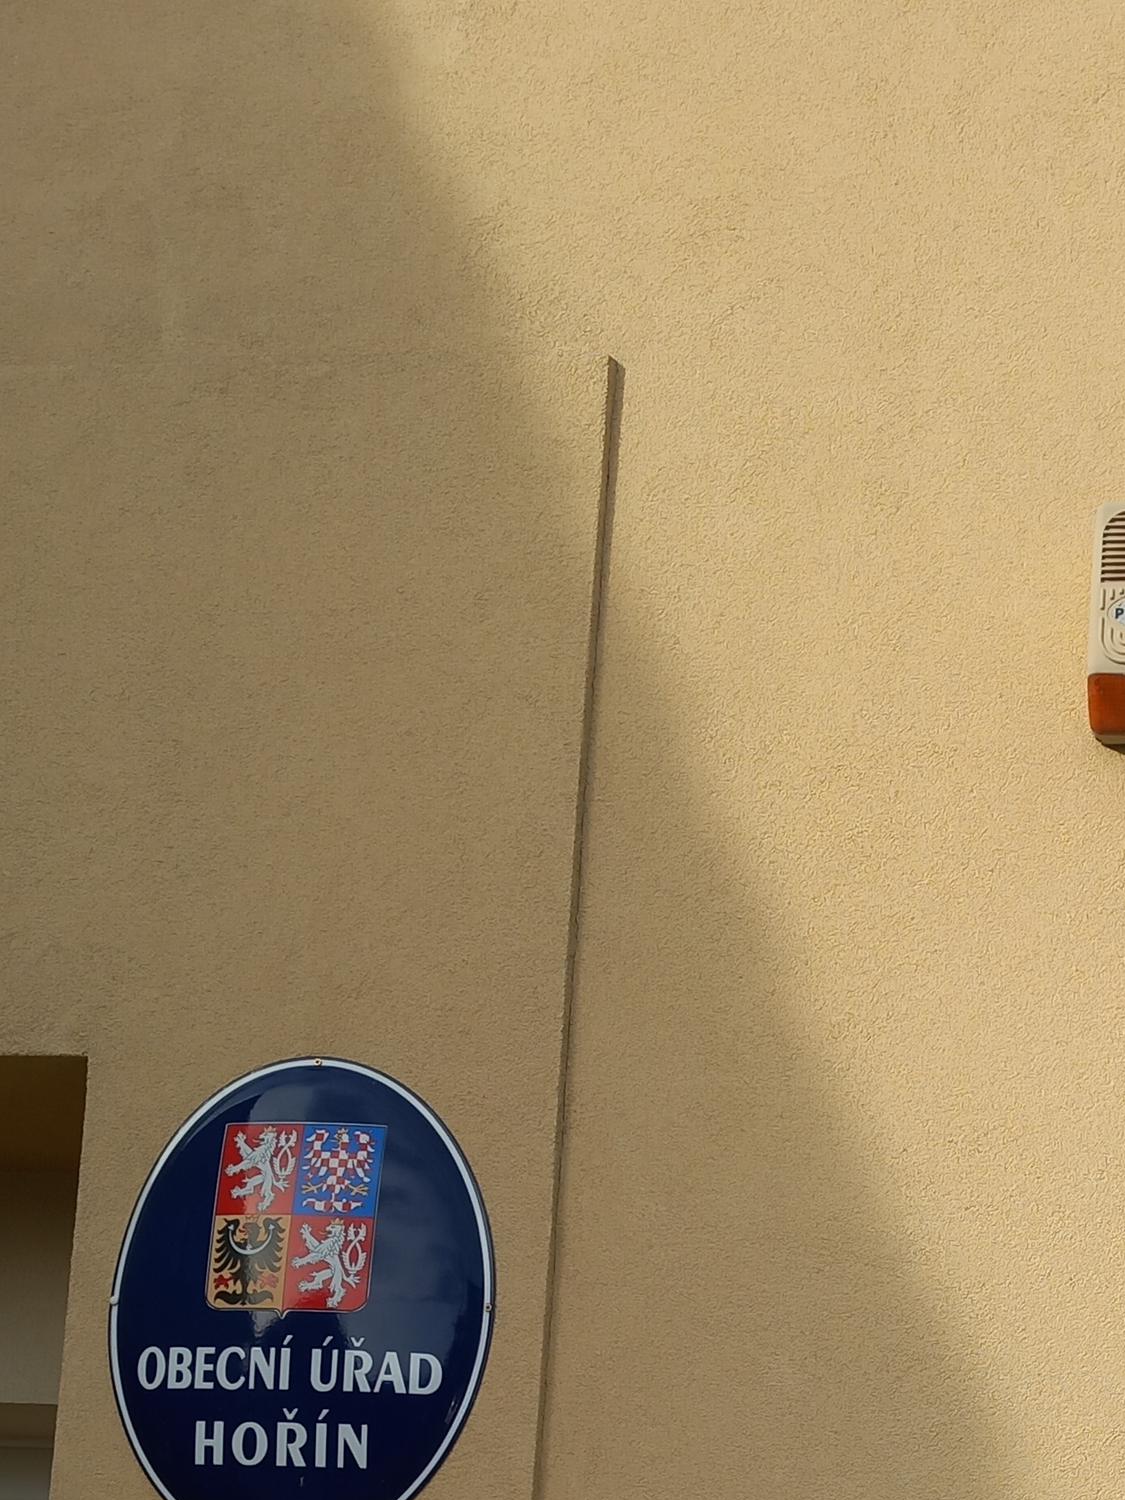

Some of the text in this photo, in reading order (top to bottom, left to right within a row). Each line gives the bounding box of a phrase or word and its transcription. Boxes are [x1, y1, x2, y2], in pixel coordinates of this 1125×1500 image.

[137, 1335, 443, 1395] OBECNÍ ÚŘAD
[194, 1408, 368, 1469] HOŘÍN
